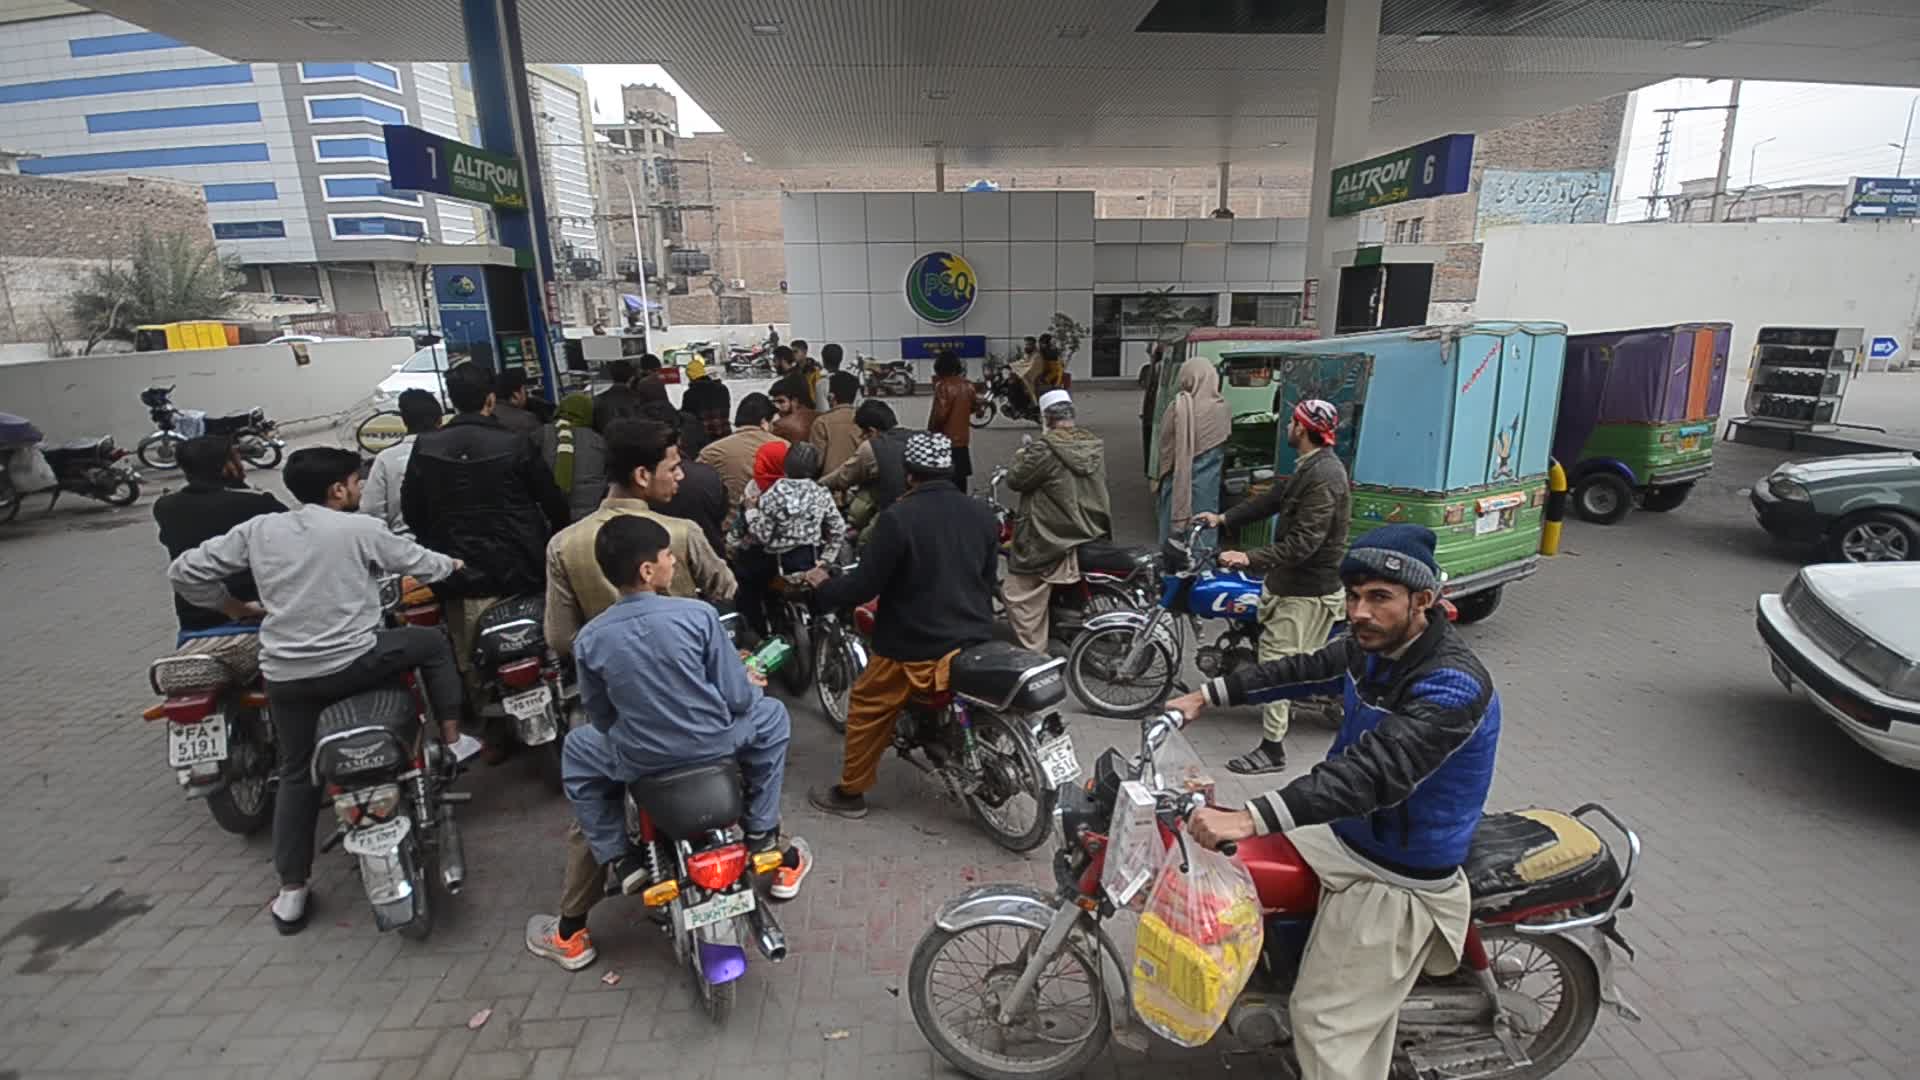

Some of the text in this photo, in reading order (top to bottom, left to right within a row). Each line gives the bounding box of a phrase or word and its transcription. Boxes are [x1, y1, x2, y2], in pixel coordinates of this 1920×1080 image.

[425, 146, 438, 180] 1
[452, 152, 519, 196] ALTRON
[1335, 158, 1411, 195] ALTRON
[1423, 154, 1436, 185] 6
[926, 271, 969, 296] PSO
[178, 738, 217, 756] 5191
